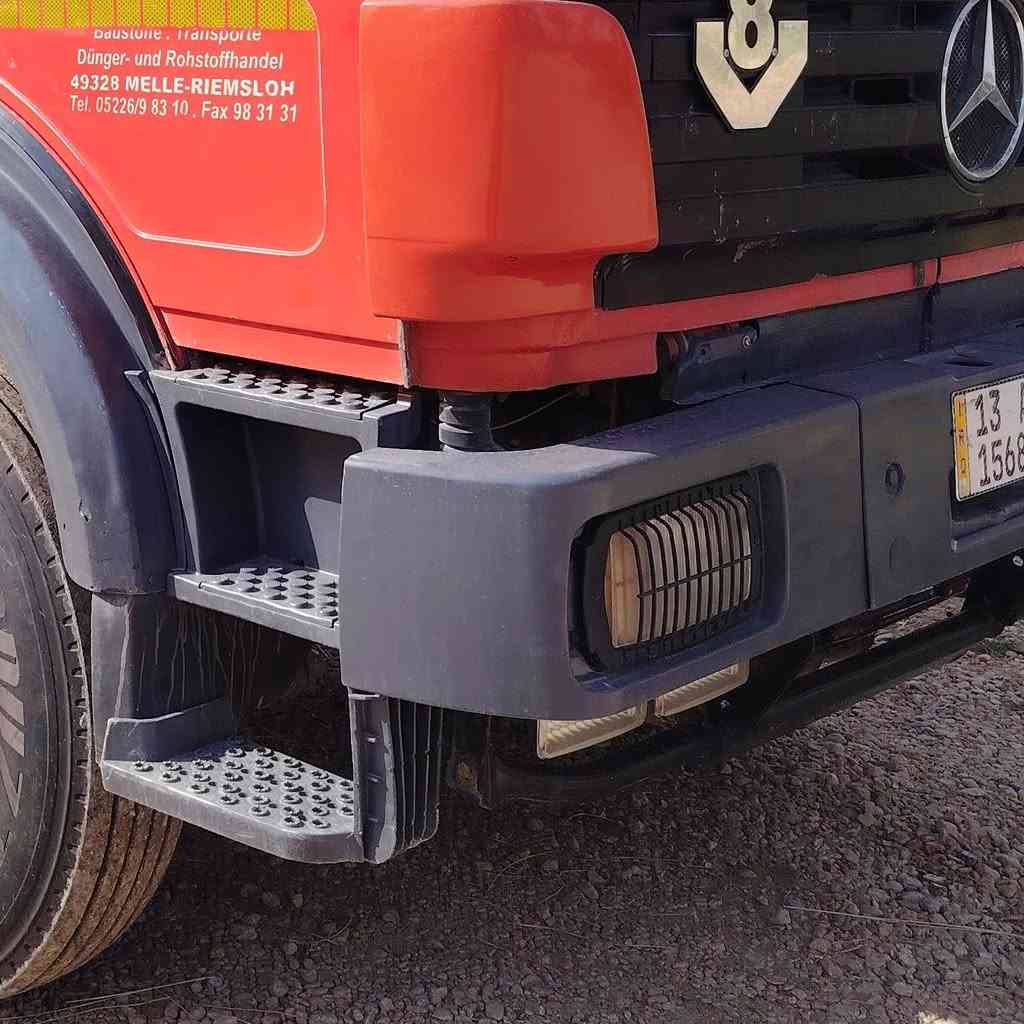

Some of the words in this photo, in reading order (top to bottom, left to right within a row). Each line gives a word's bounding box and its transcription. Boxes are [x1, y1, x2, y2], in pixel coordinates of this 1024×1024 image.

[77, 48, 130, 69] Dünger-
[135, 49, 162, 67] und
[166, 49, 284, 70] Rohstoffhandel
[70, 74, 120, 91] 49328
[125, 75, 295, 97] MELLE-RIEMSLOH
[70, 94, 92, 113] Tel.
[96, 96, 147, 115] 05226/9
[151, 98, 167, 116] 83
[172, 99, 189, 116] 10
[201, 100, 228, 120] Fax
[233, 102, 252, 121] 98
[256, 103, 274, 122] 31
[280, 103, 297, 123] 31
[975, 389, 1001, 437] 13
